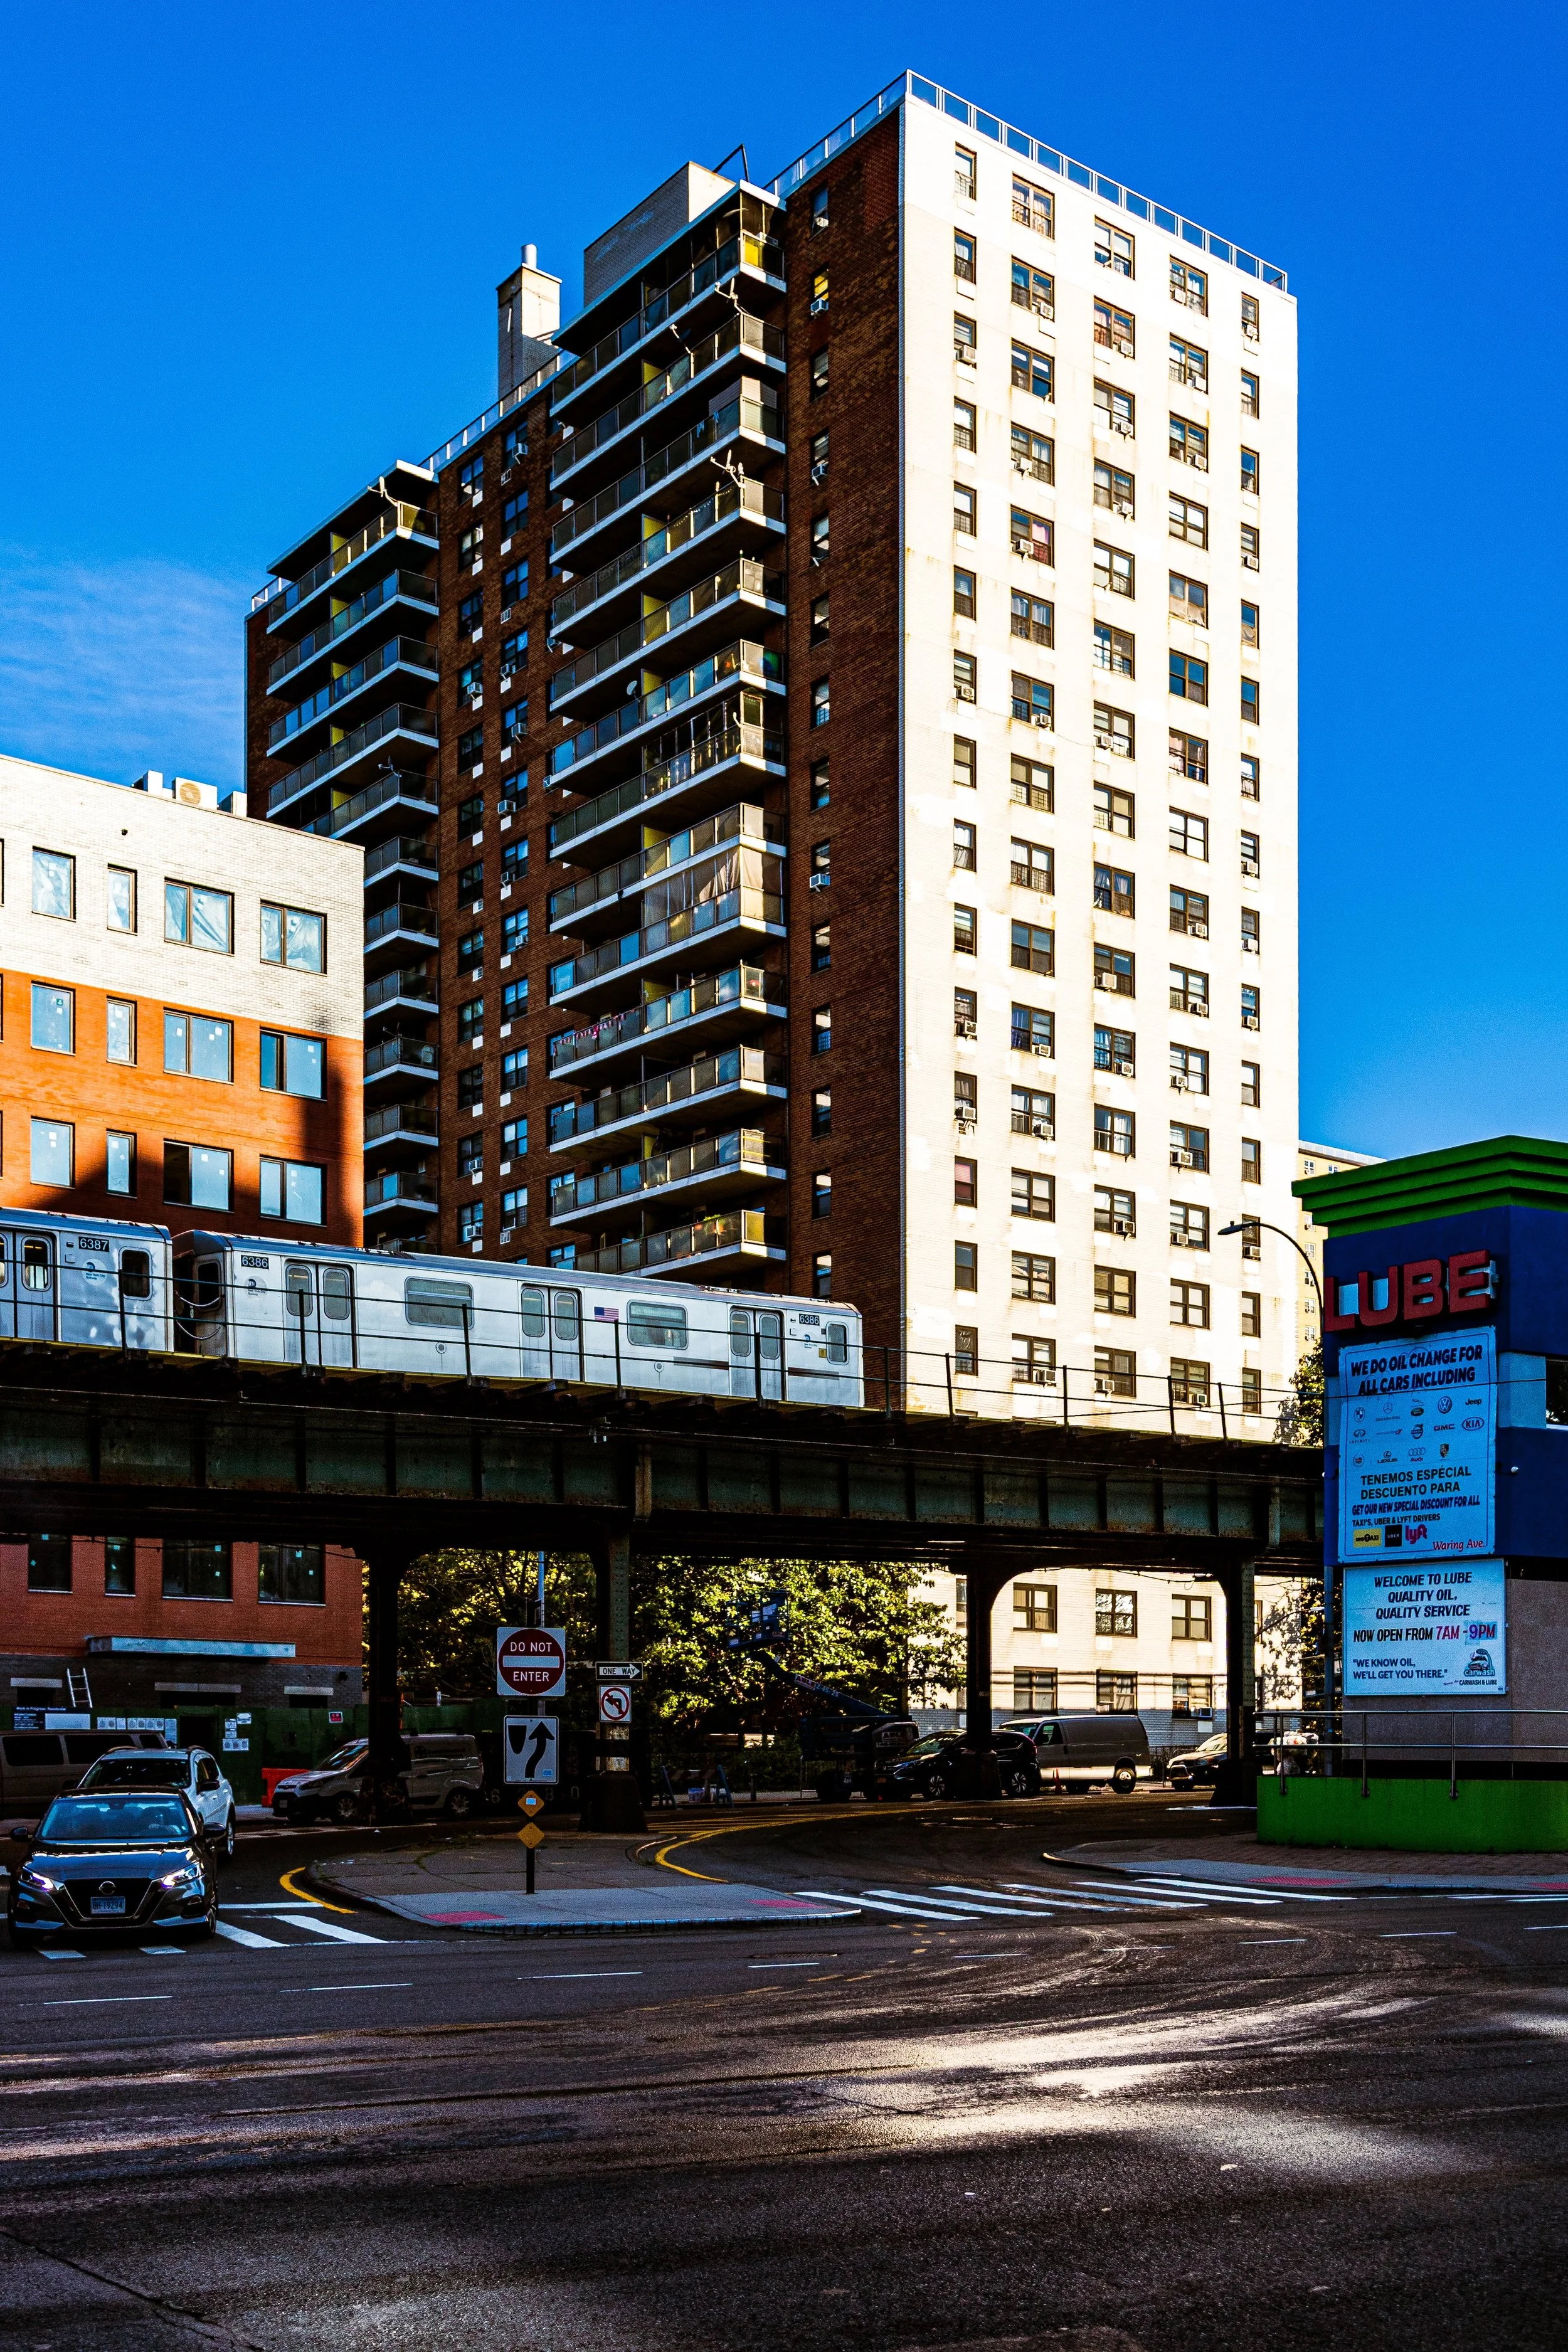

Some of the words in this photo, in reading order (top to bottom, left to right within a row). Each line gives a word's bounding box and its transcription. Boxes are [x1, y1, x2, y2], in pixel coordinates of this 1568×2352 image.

[80, 1238, 108, 1251] 6387
[242, 1256, 268, 1268] 6386
[1324, 1249, 1490, 1332] LUBE
[800, 1315, 819, 1325] 6386
[1351, 1360, 1369, 1377] WE
[1370, 1357, 1387, 1372] DO
[1389, 1355, 1407, 1372] OIL
[1409, 1347, 1458, 1369] CHANGE
[1459, 1345, 1483, 1361] FOR
[1358, 1380, 1379, 1396] ALL
[1380, 1375, 1410, 1392] CARS
[1412, 1366, 1475, 1389] INCLUDING
[1360, 1471, 1414, 1486] TENEMOS
[1416, 1465, 1471, 1481] ESPÉCIAL
[1360, 1484, 1427, 1500] DESCUENTO
[1431, 1481, 1460, 1494] PARA
[1352, 1504, 1365, 1515] GET
[1365, 1503, 1377, 1515] OUR
[1378, 1502, 1393, 1513] NEW
[1394, 1500, 1419, 1512] SPECIAL
[1420, 1497, 1453, 1510] DISCOUNT
[1454, 1496, 1468, 1507] FOR
[1468, 1495, 1480, 1506] ALL
[1352, 1518, 1373, 1527] TAXI'S,
[1374, 1516, 1390, 1525] UBER
[1392, 1516, 1396, 1524] &
[1397, 1515, 1412, 1523] LYFT
[1413, 1513, 1441, 1523] DRIVERS
[1433, 1540, 1463, 1552] Waring
[1466, 1539, 1485, 1549] Ave.
[1374, 1574, 1424, 1587] WELCOME
[1428, 1573, 1441, 1585] TO
[1444, 1572, 1472, 1584] LUBE
[1388, 1589, 1434, 1603] QUALITY
[1436, 1589, 1458, 1601] OIL,
[1376, 1606, 1421, 1619] QUALITY
[1424, 1604, 1470, 1618] SERVICE
[1353, 1629, 1375, 1643] NOW
[1377, 1628, 1403, 1642] OPEN
[1405, 1627, 1433, 1641] FROM
[1436, 1625, 1460, 1640] 7AM
[511, 1642, 525, 1652] DO
[530, 1642, 552, 1652] NOT
[1371, 1658, 1398, 1668] KNOW
[1400, 1658, 1416, 1668] OIL,
[513, 1671, 549, 1682] ENTER
[1353, 1670, 1376, 1679] WE'LL
[1378, 1670, 1394, 1679] GET
[1395, 1669, 1414, 1678] YOU
[1416, 1668, 1448, 1678] THERE."
